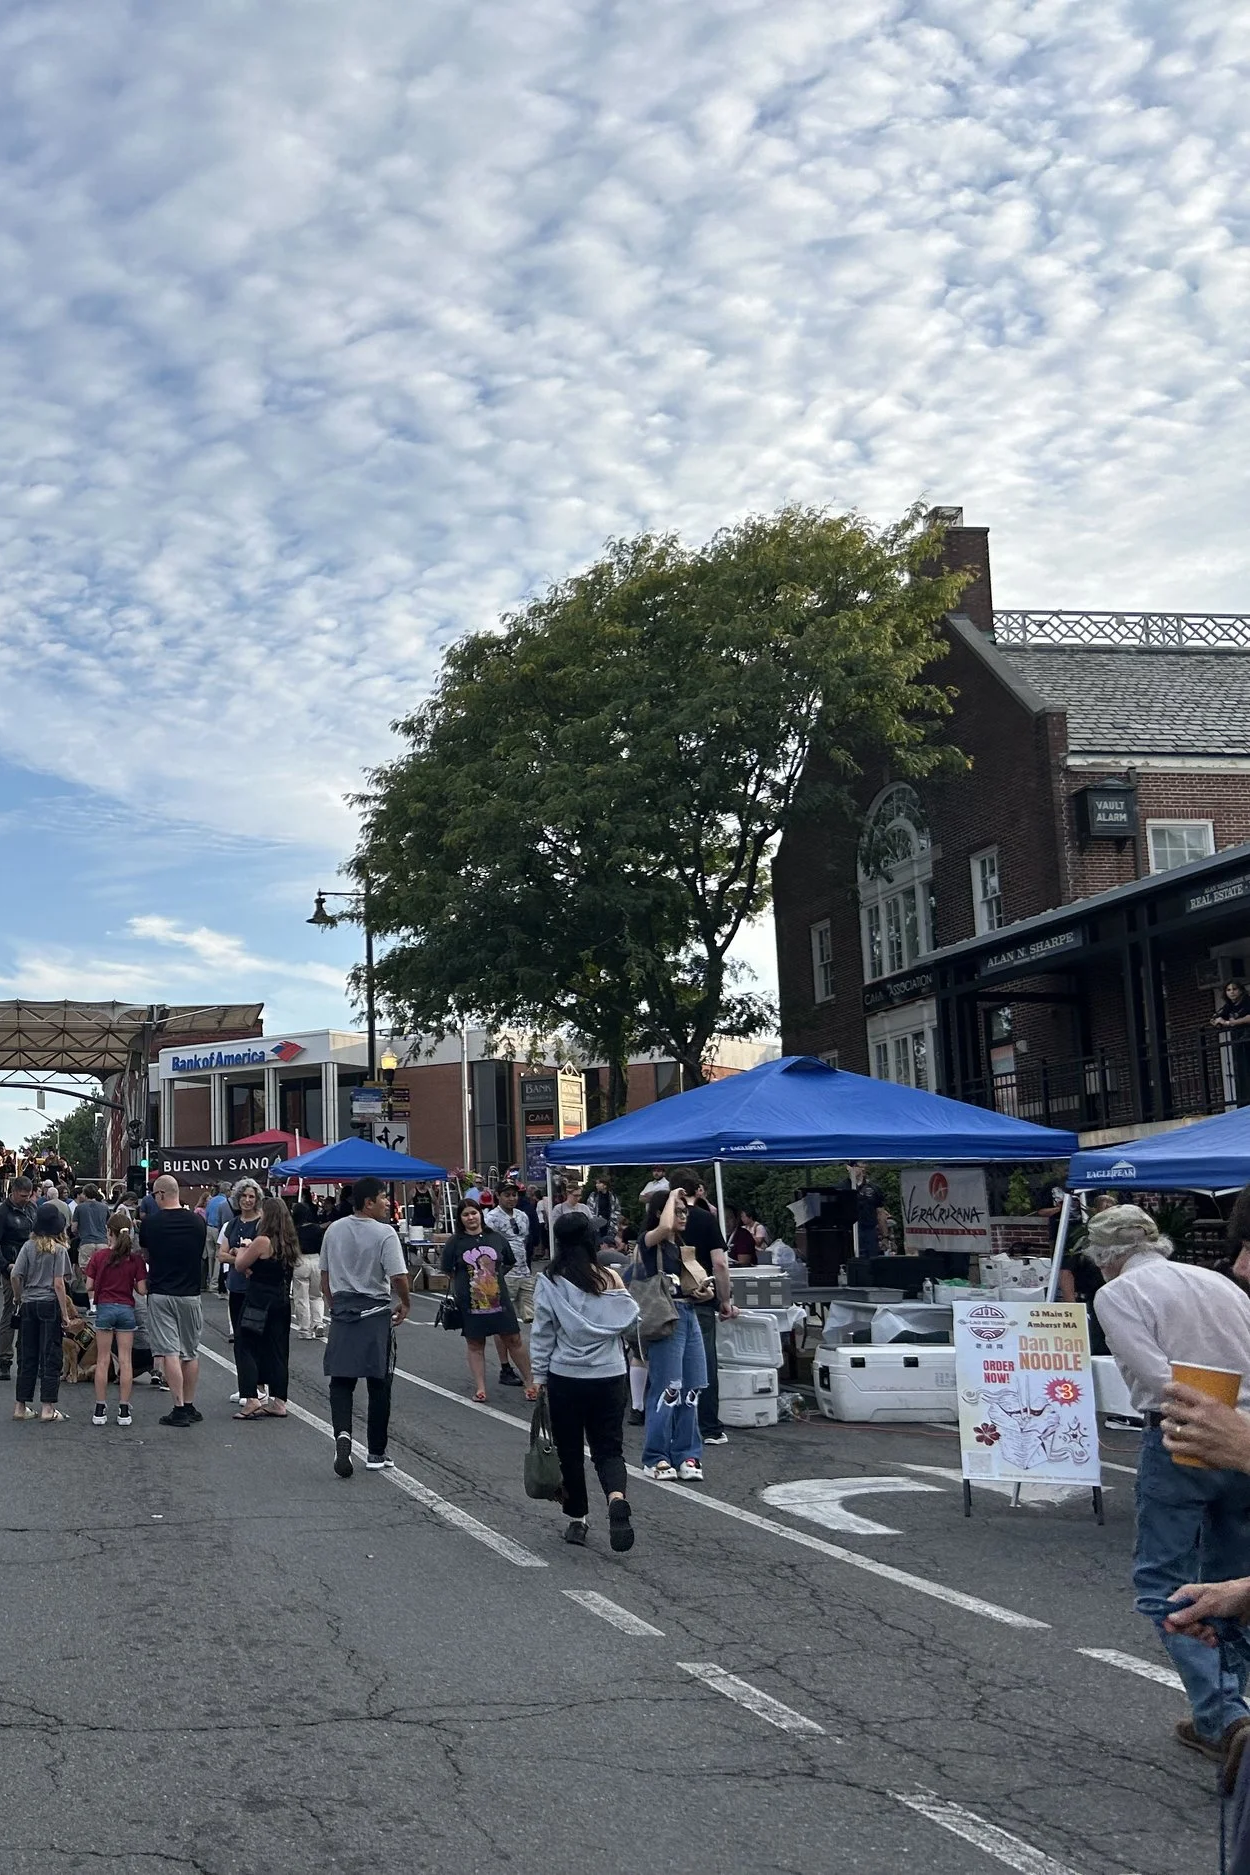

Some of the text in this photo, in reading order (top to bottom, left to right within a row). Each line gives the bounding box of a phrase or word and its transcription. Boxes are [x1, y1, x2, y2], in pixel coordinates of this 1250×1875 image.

[1095, 801, 1125, 810] VAULT
[1096, 813, 1128, 822] ALARM
[1189, 894, 1212, 910] REAL
[1213, 884, 1244, 902] ESTATE
[987, 951, 1014, 968] ALAN
[1029, 932, 1074, 955] SHARPE
[171, 1048, 266, 1072] Bank of America
[163, 1156, 270, 1173] BUENO Y SANO
[1027, 1321, 1061, 1329] Amherst
[1018, 1335, 1084, 1353] Dan Dan
[983, 1360, 1015, 1372] ORDER
[1019, 1352, 1083, 1372] NOODLE
[984, 1372, 1011, 1384] NOW!
[1054, 1383, 1074, 1400] $3
